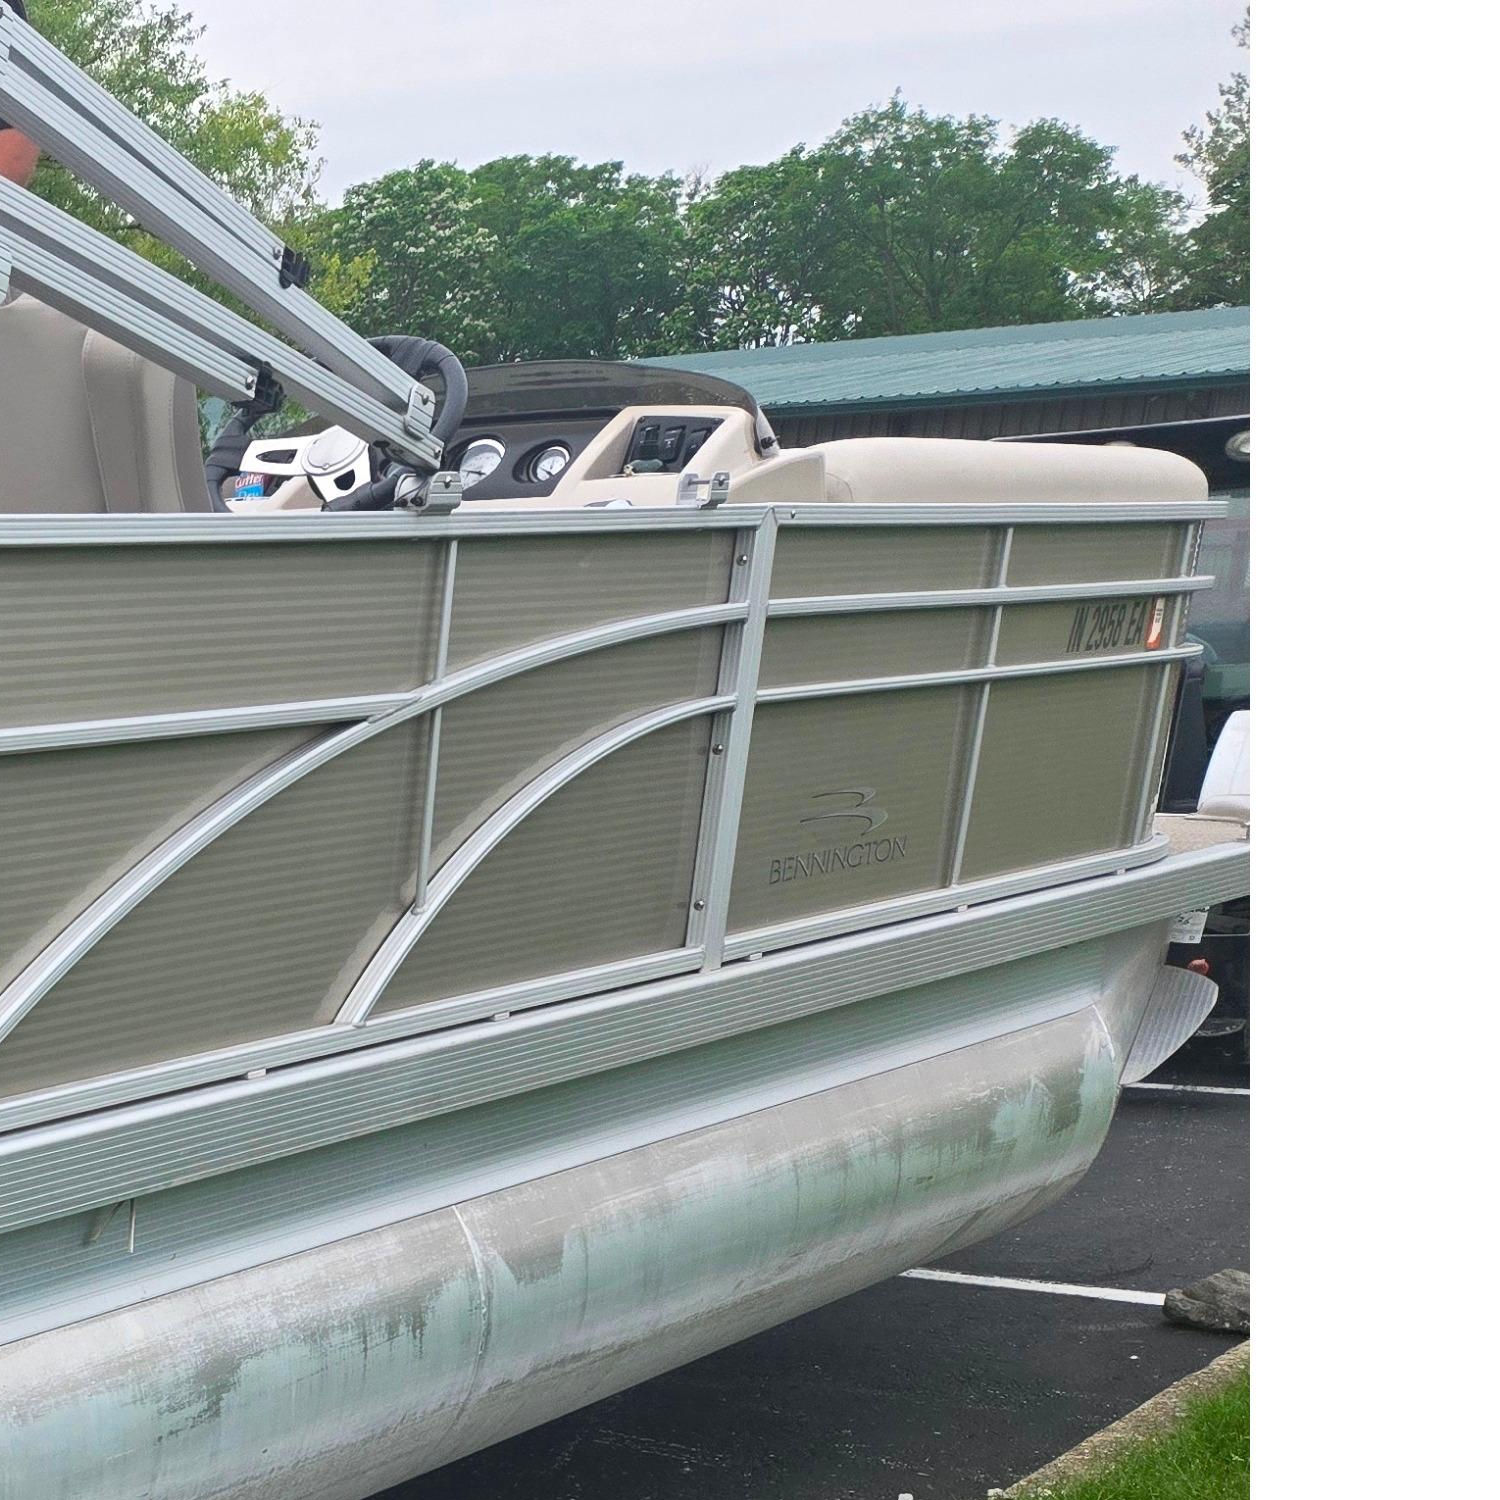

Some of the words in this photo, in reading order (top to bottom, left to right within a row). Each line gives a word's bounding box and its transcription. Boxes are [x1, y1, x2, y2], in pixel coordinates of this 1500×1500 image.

[1066, 605, 1089, 653] IN
[1124, 601, 1148, 646] EA
[768, 835, 908, 885] BENNINGTON
